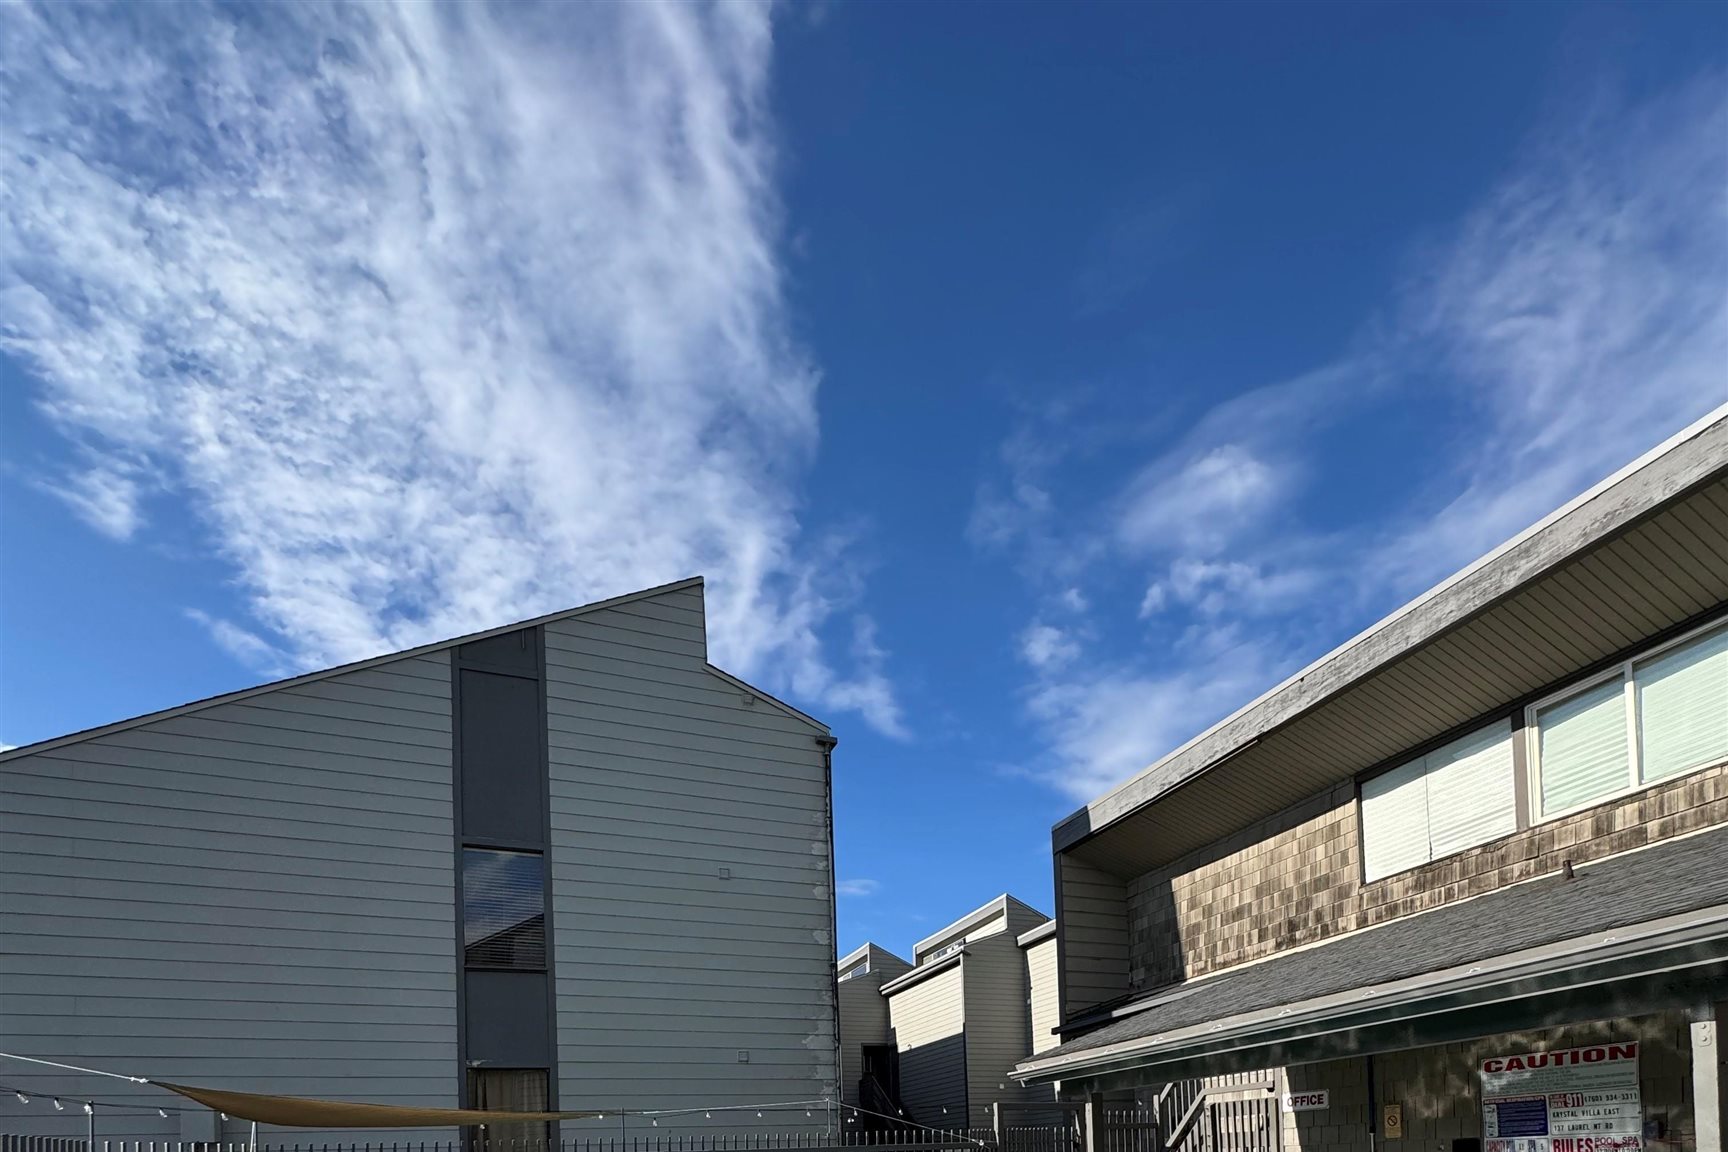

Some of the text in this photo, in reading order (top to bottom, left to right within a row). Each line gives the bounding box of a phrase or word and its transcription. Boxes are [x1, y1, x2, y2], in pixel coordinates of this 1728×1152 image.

[1483, 1043, 1636, 1073] CAUTION
[1287, 1094, 1324, 1107] OFFICE
[1566, 1093, 1583, 1107] 911
[1552, 1110, 1578, 1118] KRYSTAL
[1568, 1123, 1590, 1131] LAUREL
[1594, 1136, 1616, 1146] POOL
[1622, 1136, 1639, 1145] SPA
